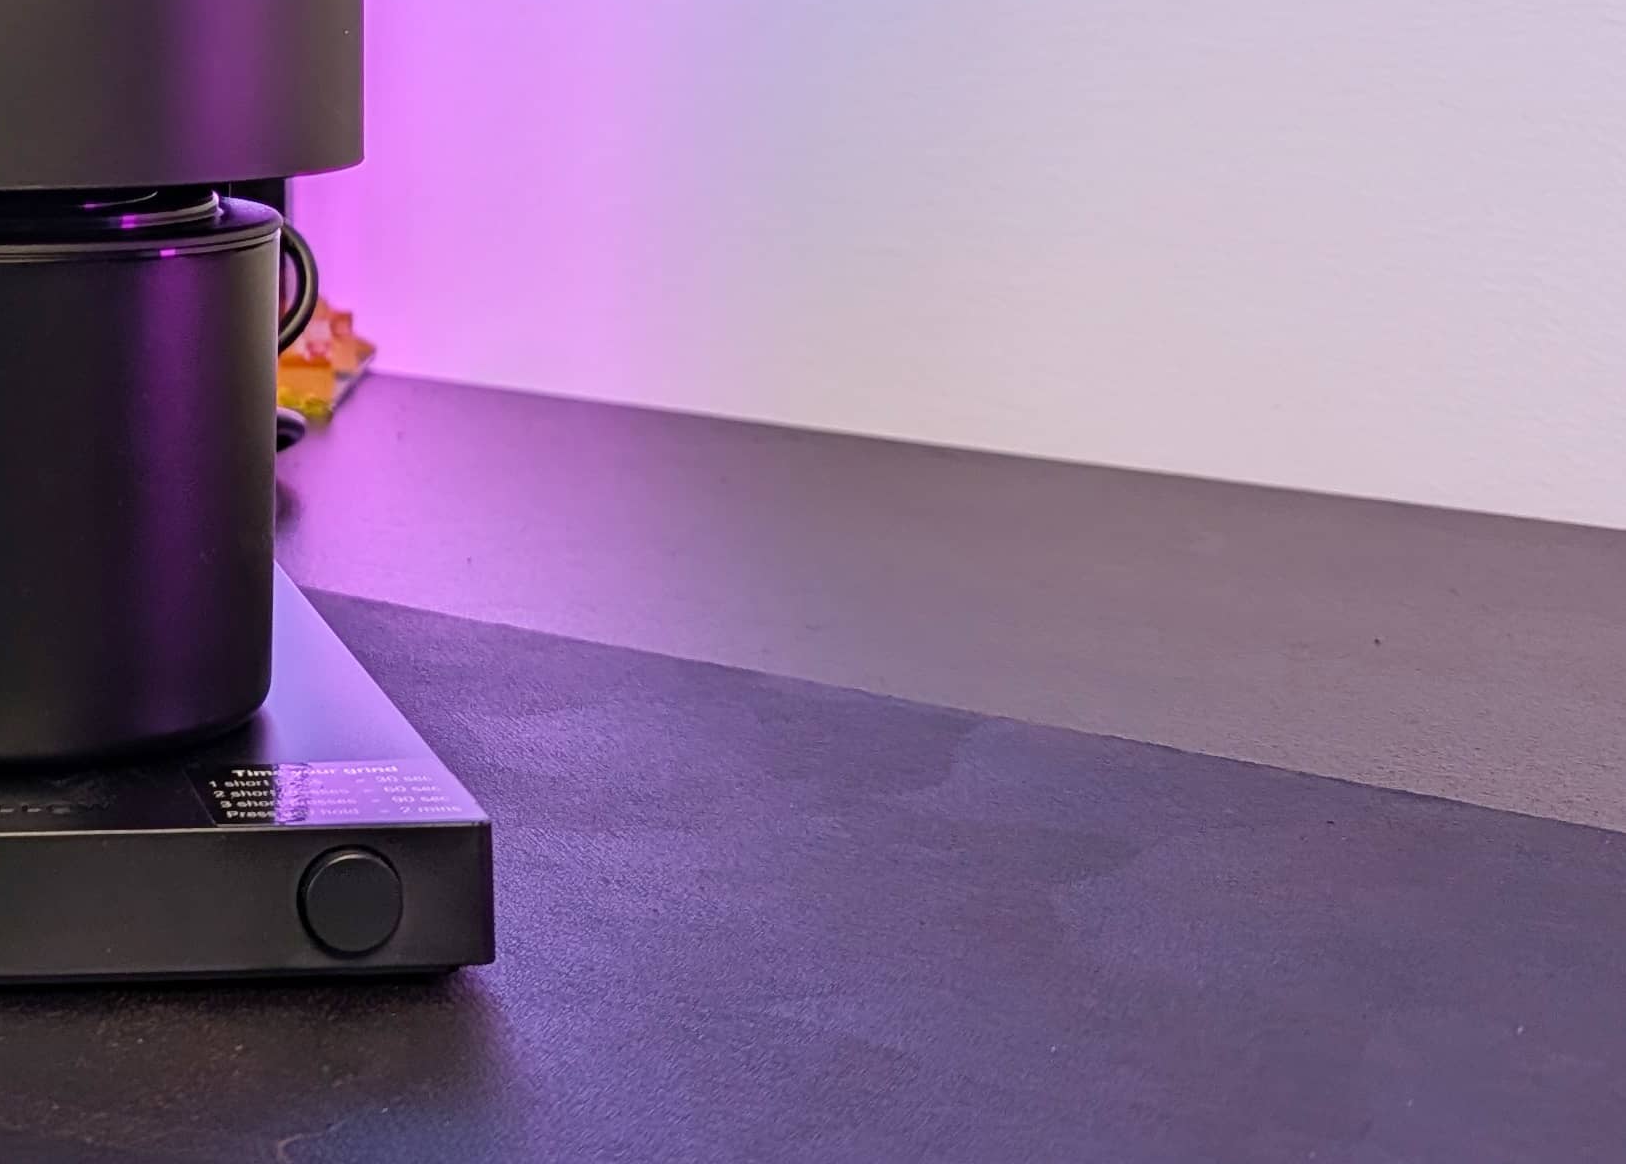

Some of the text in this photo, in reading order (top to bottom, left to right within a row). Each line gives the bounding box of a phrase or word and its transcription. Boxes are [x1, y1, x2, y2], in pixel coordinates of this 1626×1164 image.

[342, 765, 398, 775] grind
[208, 780, 217, 788] 1
[224, 779, 270, 787] short
[213, 790, 225, 798] 2
[230, 789, 277, 798] short
[220, 800, 232, 808] 3
